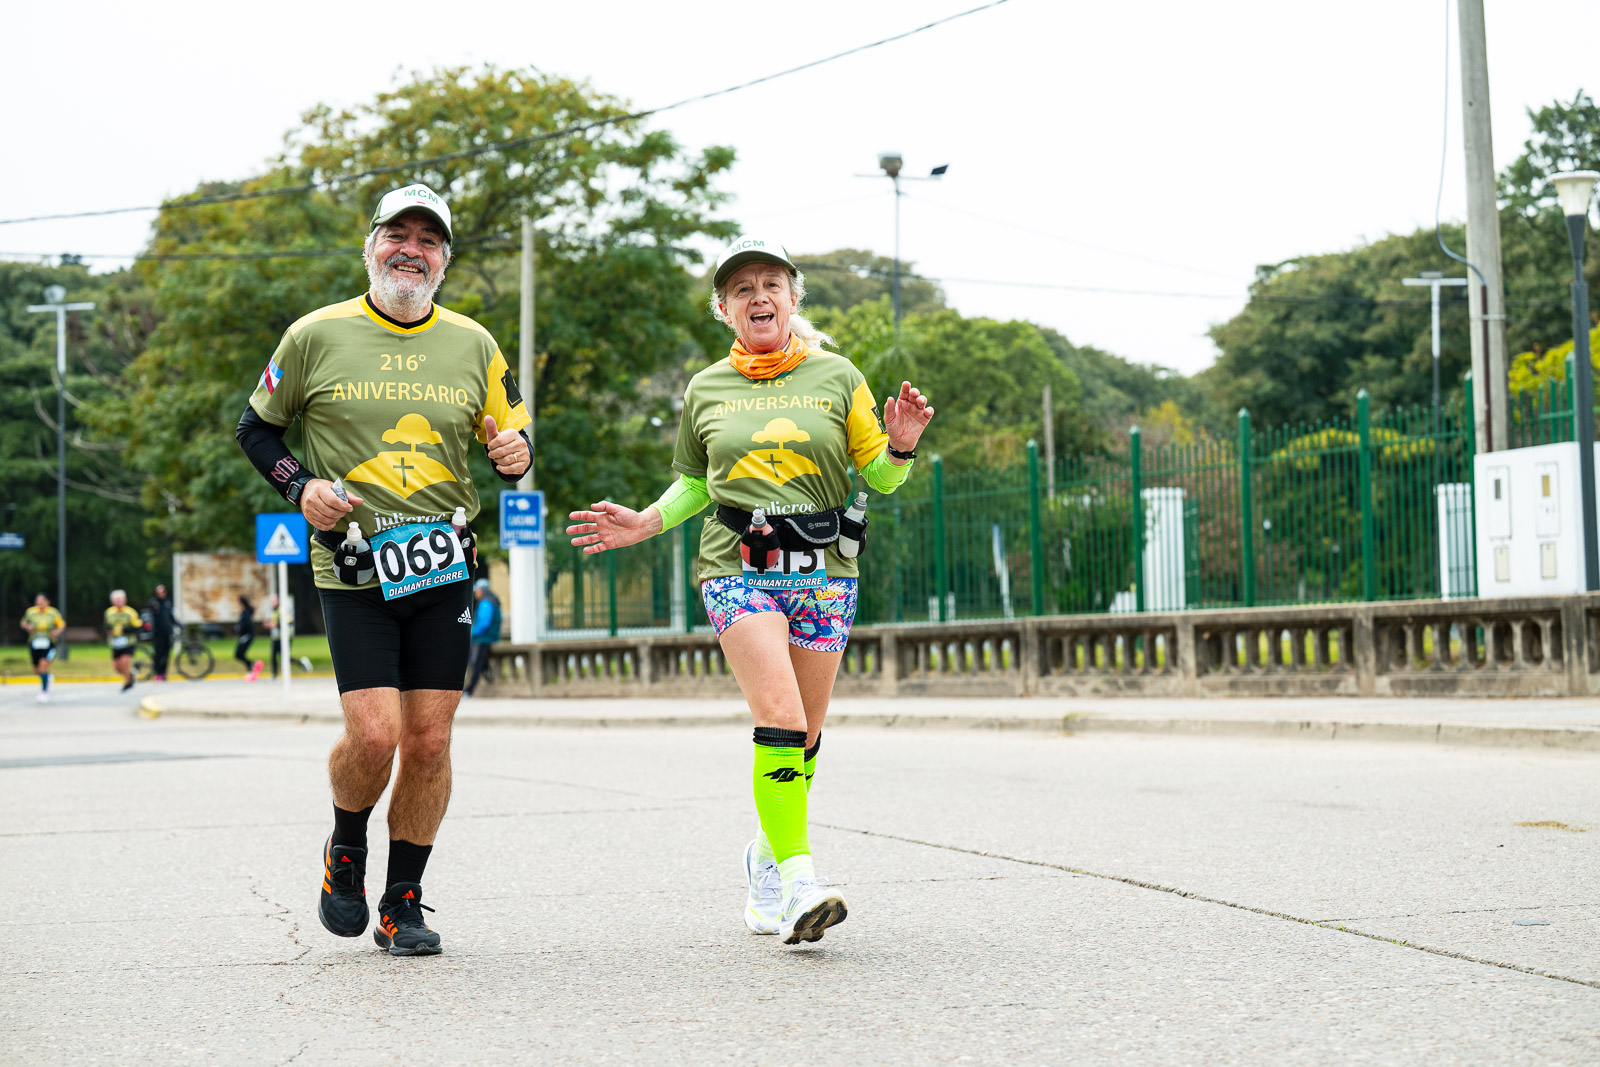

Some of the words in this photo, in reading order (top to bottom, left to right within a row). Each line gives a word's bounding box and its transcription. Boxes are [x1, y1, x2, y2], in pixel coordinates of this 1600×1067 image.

[404, 189, 439, 204] MCM
[731, 239, 765, 255] MCM
[380, 353, 427, 372] 216°
[332, 381, 468, 407] ANIVERSARIO
[713, 395, 833, 418] ANIVERSARIO
[755, 500, 816, 516] ulicroc
[379, 528, 455, 584] 069
[388, 577, 432, 597] DIAMANTE
[433, 570, 464, 584] CORRE
[747, 577, 793, 587] DIAMANTE
[794, 576, 823, 587] CORRE
